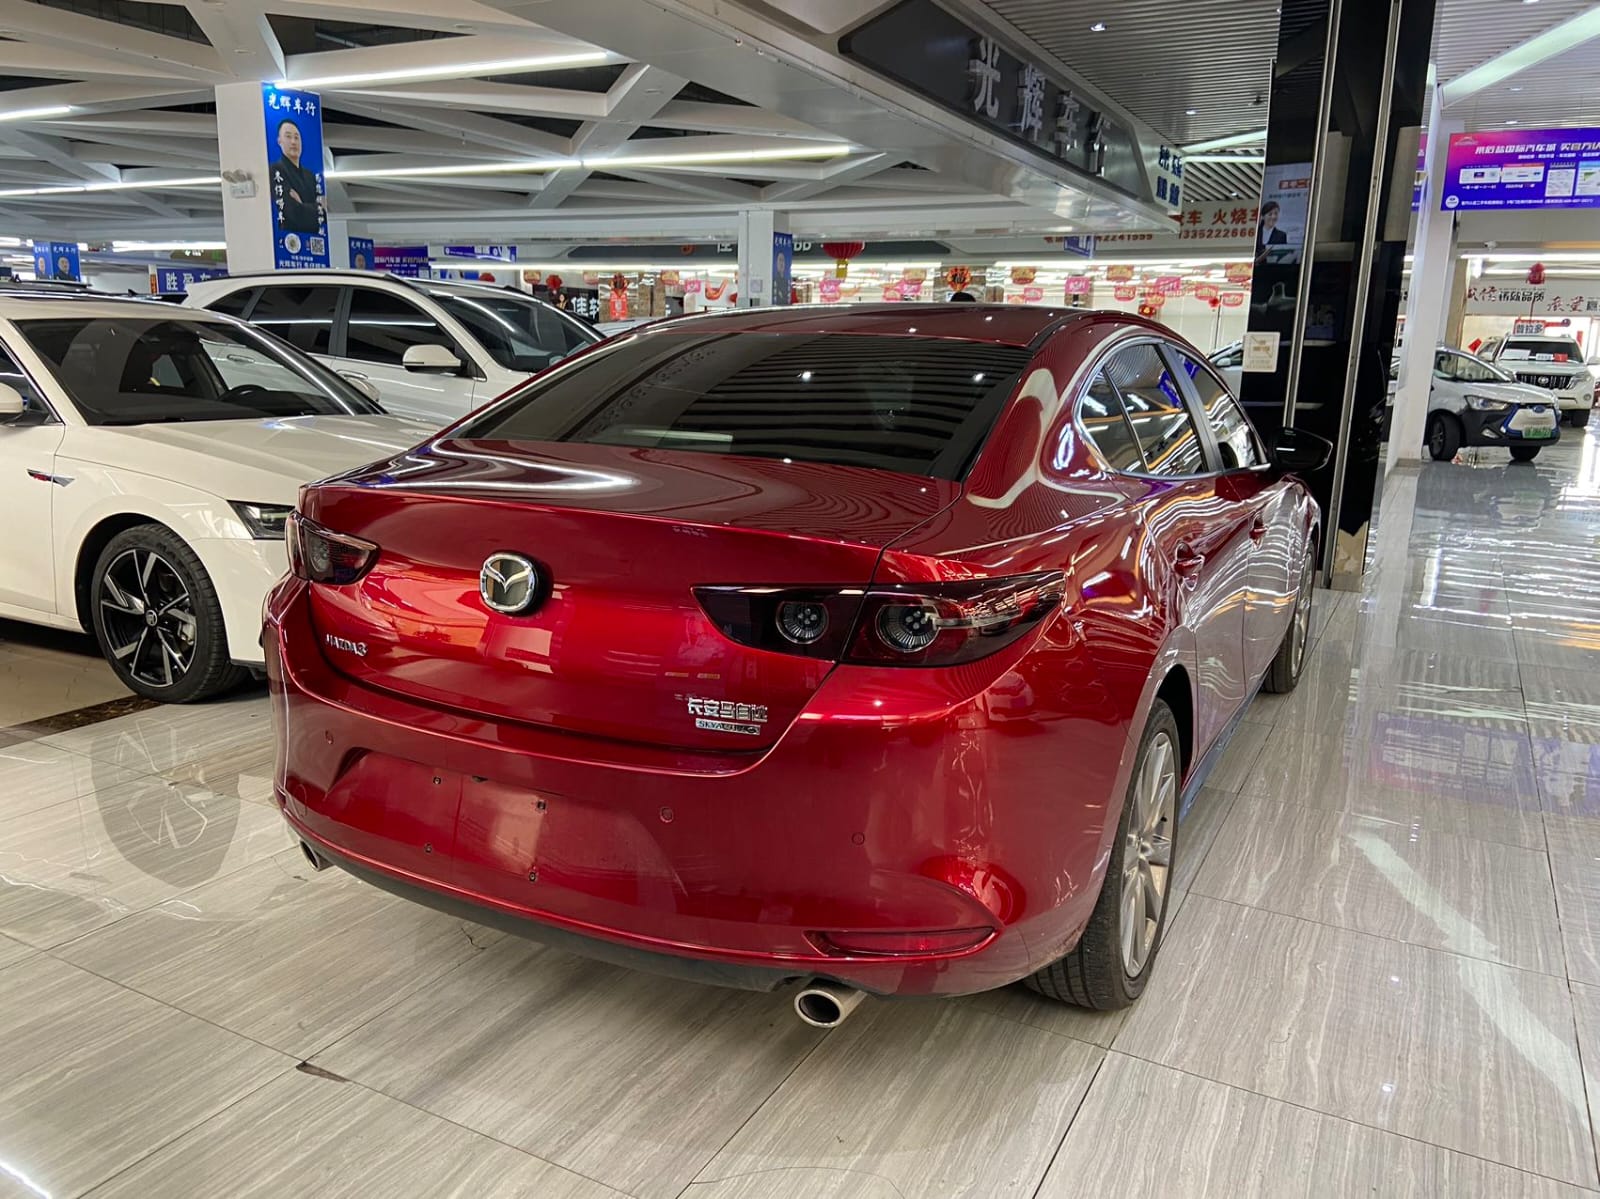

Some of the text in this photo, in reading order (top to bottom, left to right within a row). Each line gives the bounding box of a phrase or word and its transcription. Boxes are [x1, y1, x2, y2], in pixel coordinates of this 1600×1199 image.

[268, 92, 316, 117] 光辉车行
[688, 697, 768, 722] 长安马自达
